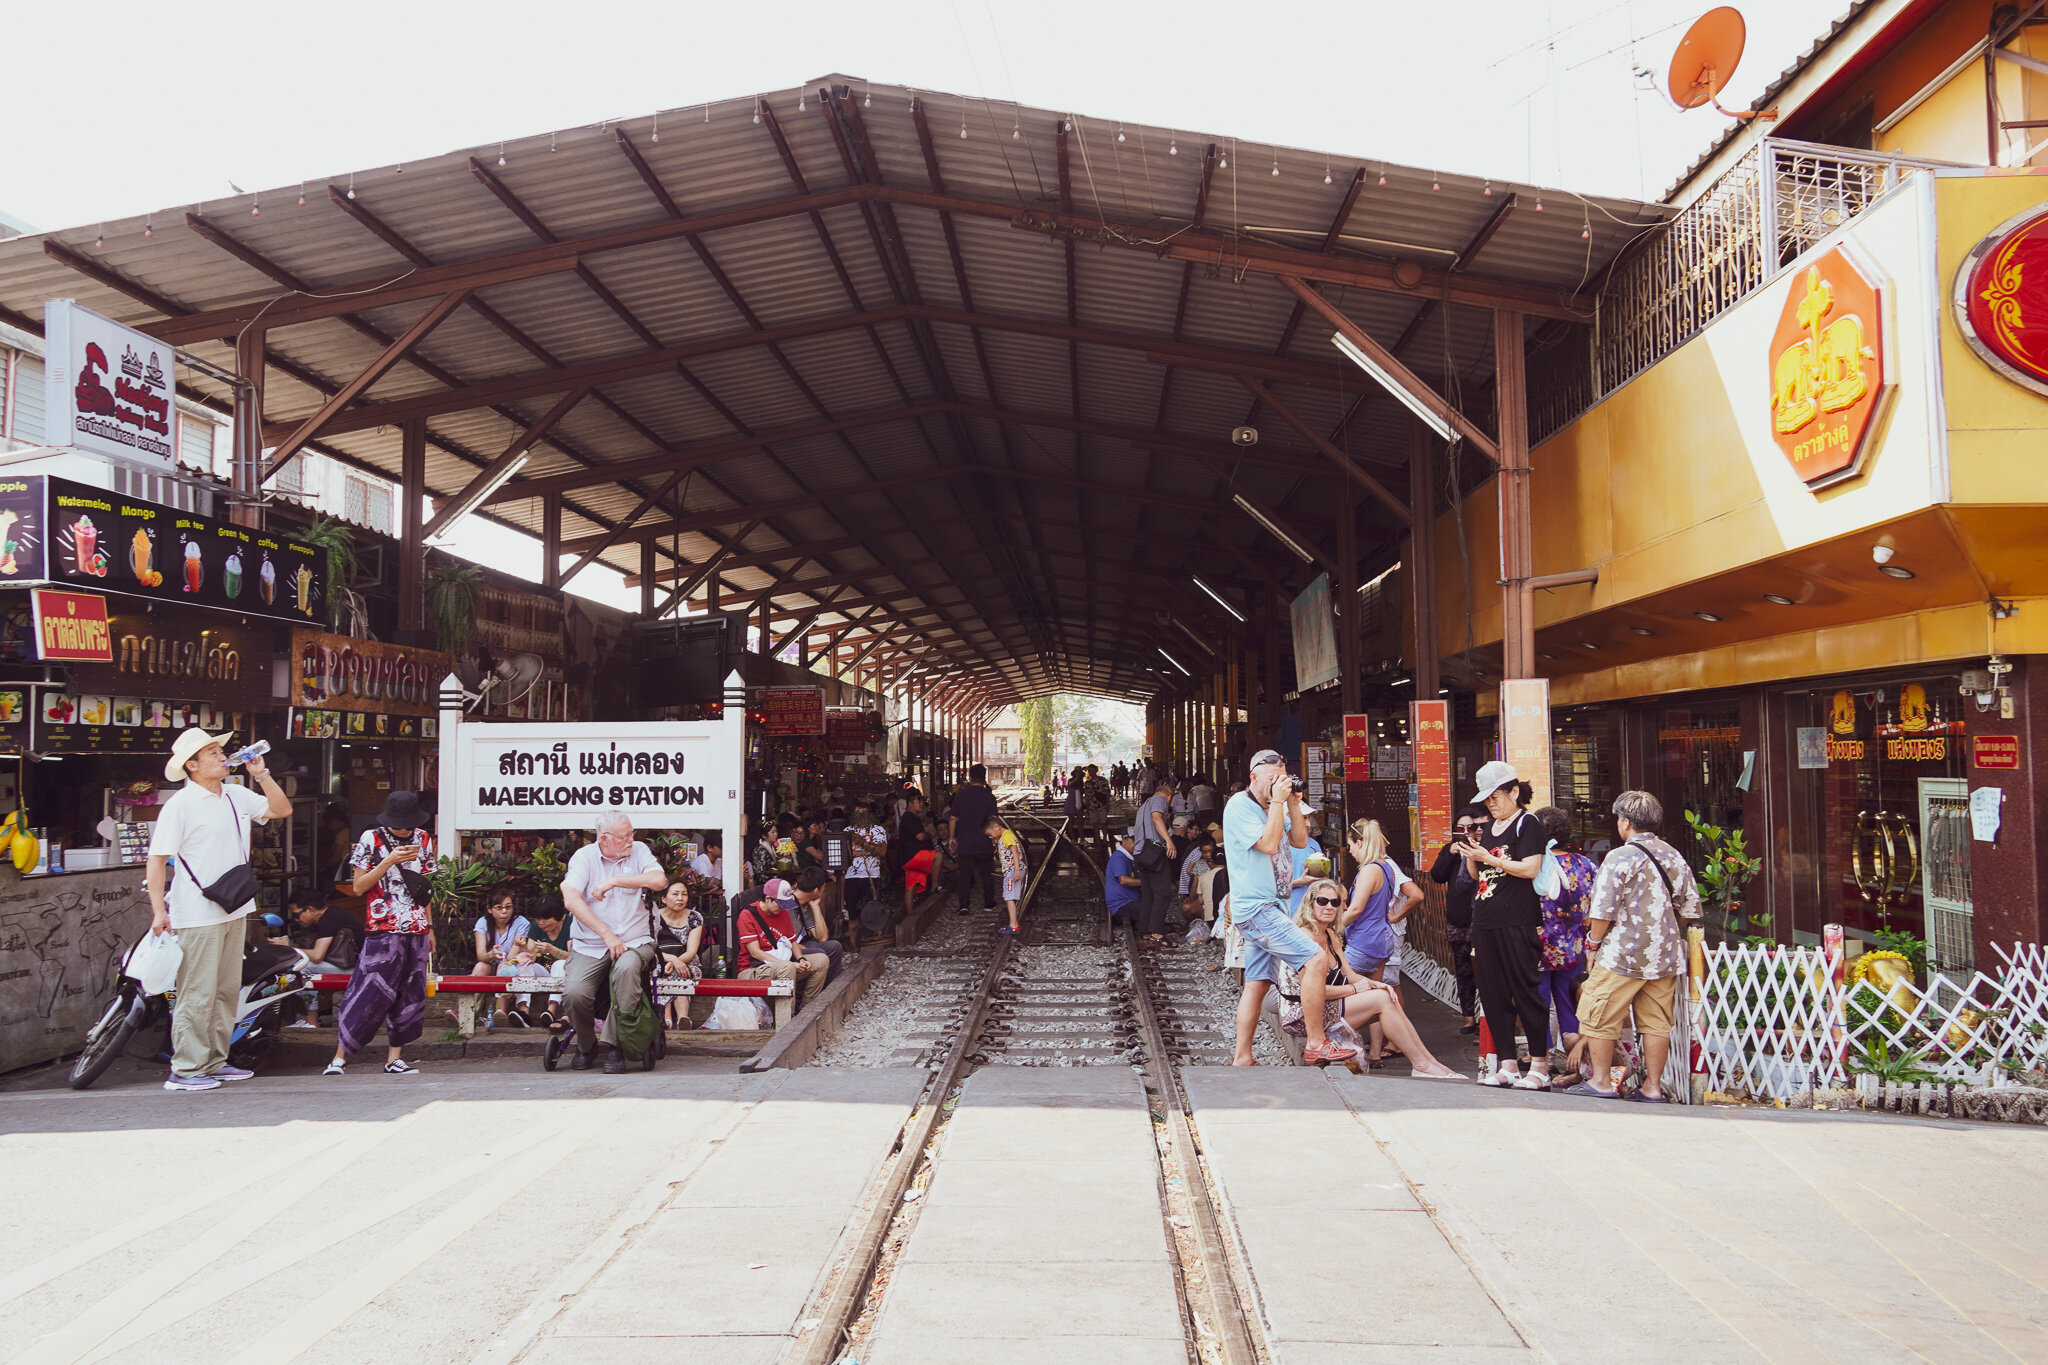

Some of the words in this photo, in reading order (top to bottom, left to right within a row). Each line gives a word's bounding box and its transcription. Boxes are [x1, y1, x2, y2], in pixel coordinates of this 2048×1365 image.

[1793, 414, 1849, 463] ตราช้างคู่
[57, 495, 111, 512] Watermelon
[121, 505, 156, 520] Mango
[176, 519, 191, 529] Milk
[193, 521, 204, 530] tea
[218, 527, 238, 539] Green
[239, 531, 249, 542] tea
[258, 538, 279, 550] coffee
[289, 543, 315, 556] Pineapple
[498, 742, 571, 776] สถานี
[579, 742, 685, 775] แม่กลอง
[478, 786, 604, 807] MAEKLONG
[608, 785, 704, 806] STATION
